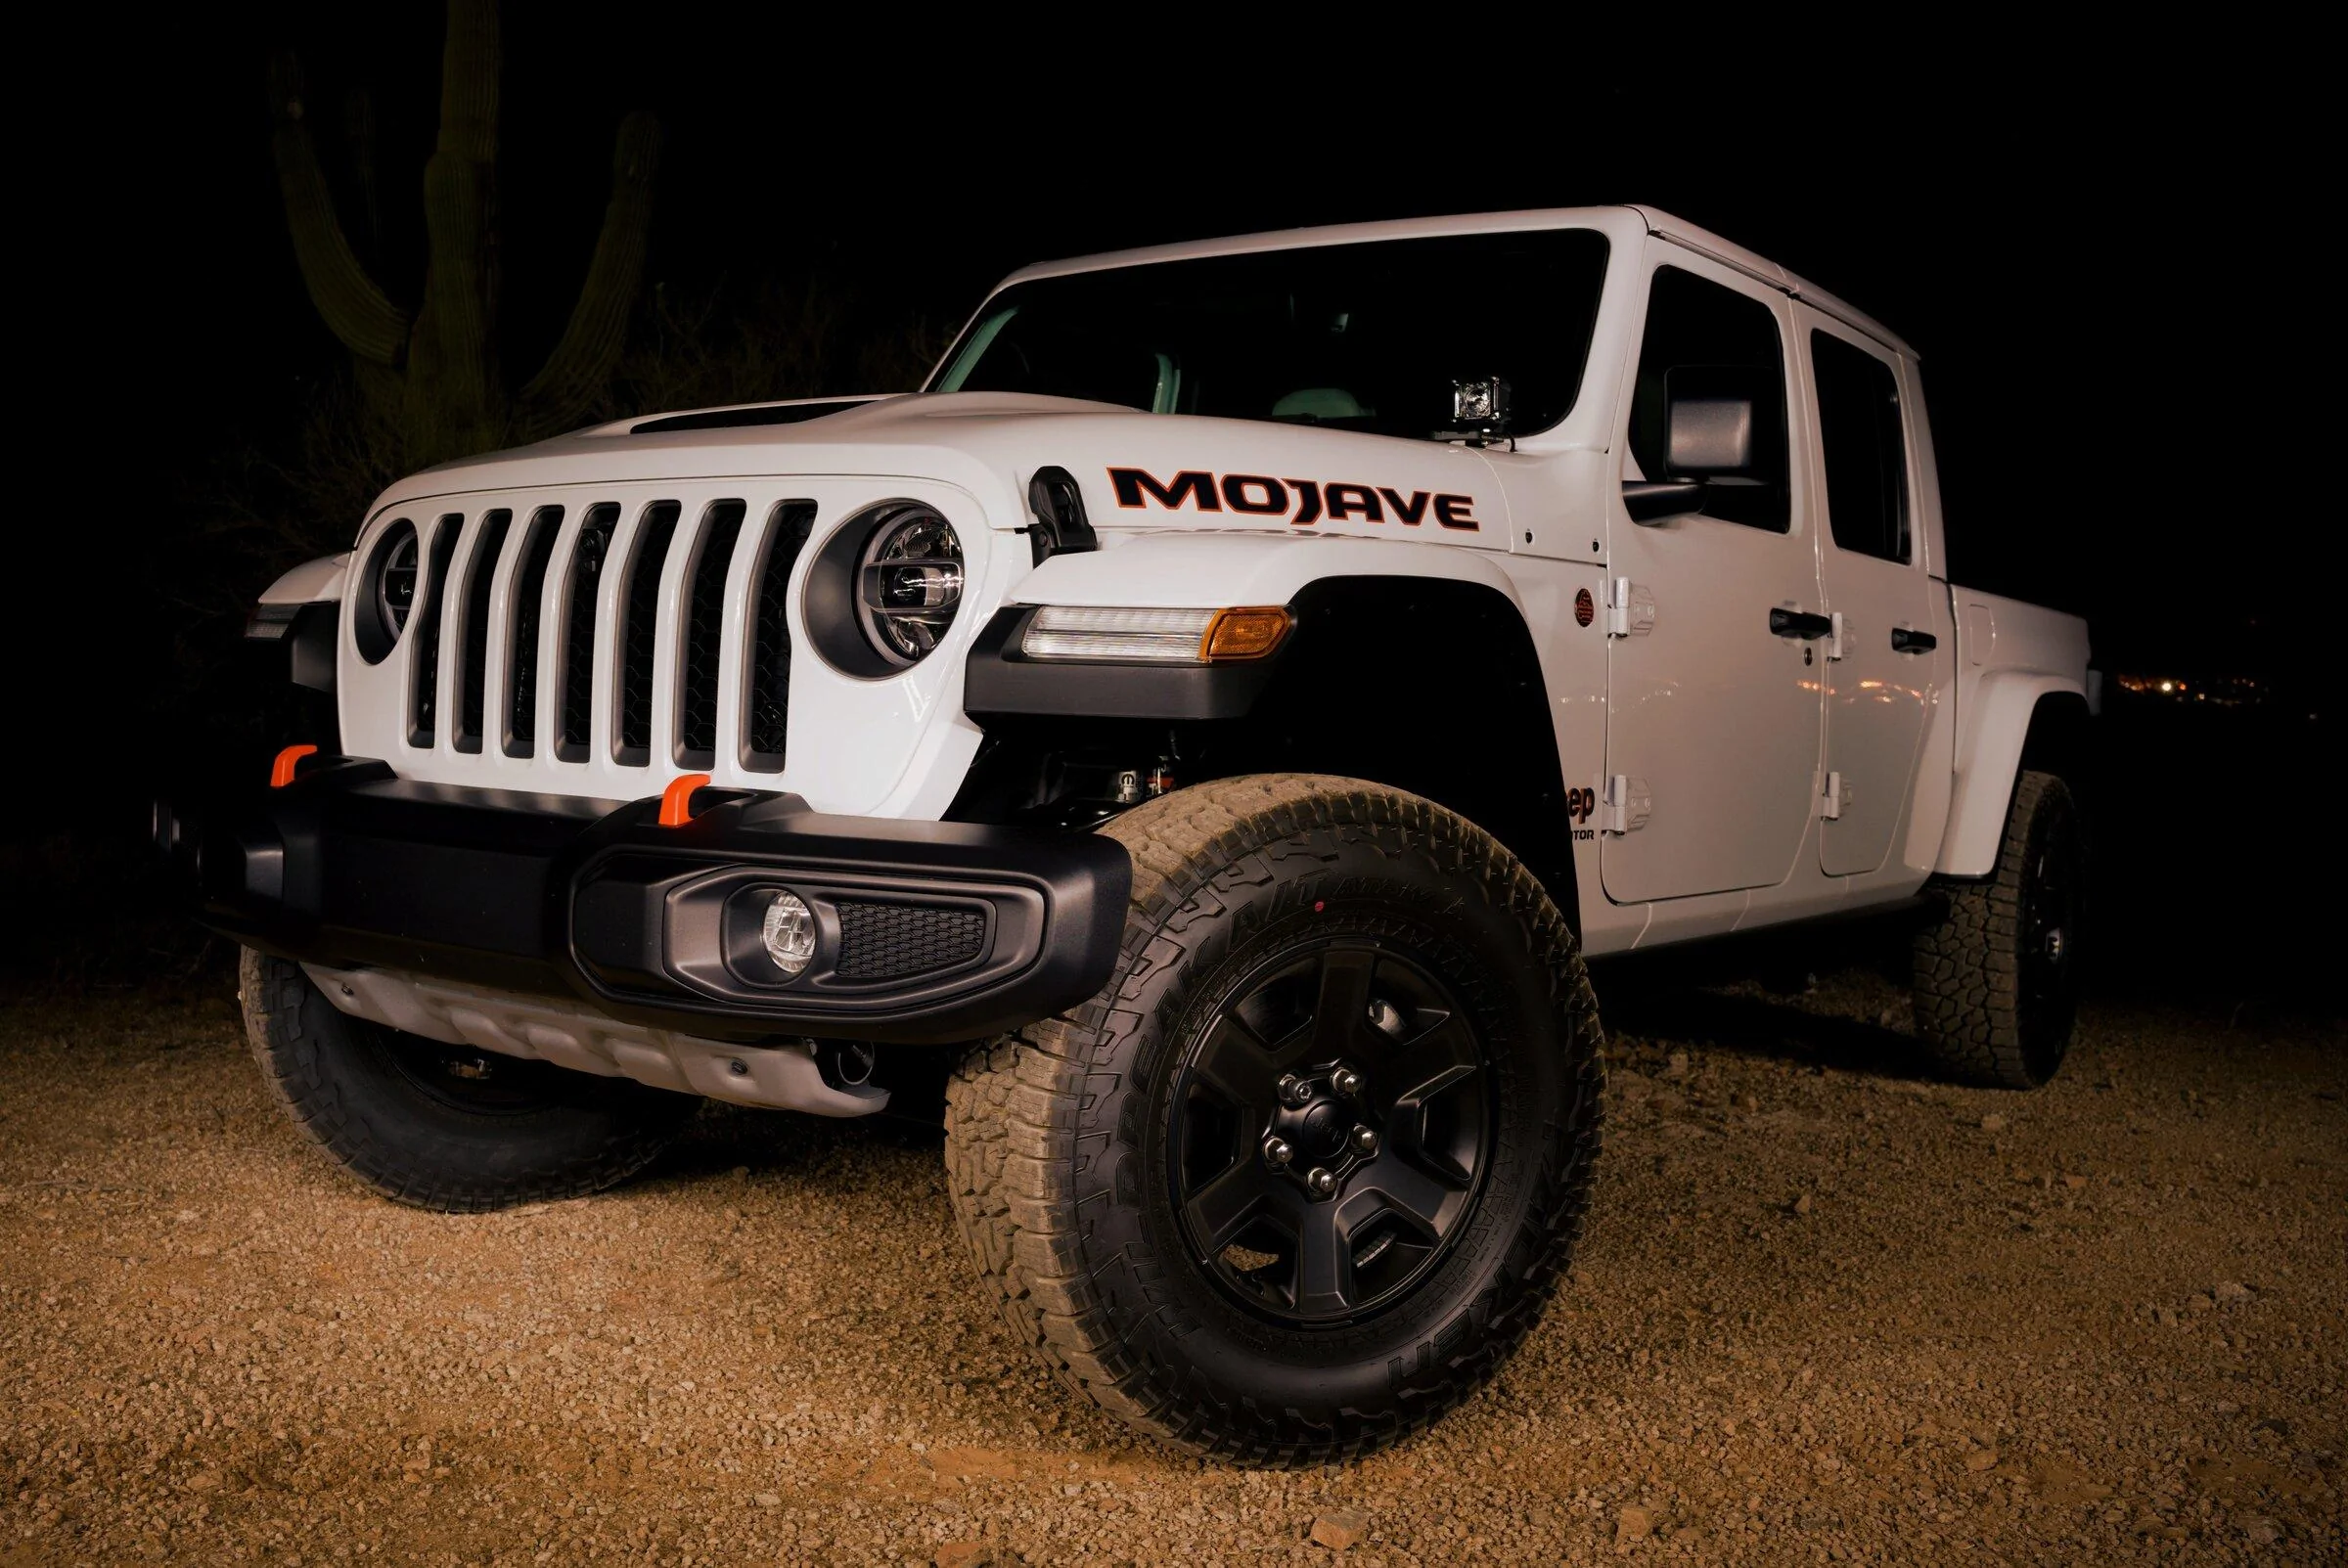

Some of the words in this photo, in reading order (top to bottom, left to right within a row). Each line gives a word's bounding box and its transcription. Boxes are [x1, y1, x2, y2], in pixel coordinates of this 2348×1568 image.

[1106, 467, 1480, 532] MOJAVE
[1566, 787, 1595, 825] ep
[1570, 829, 1595, 840] TOR
